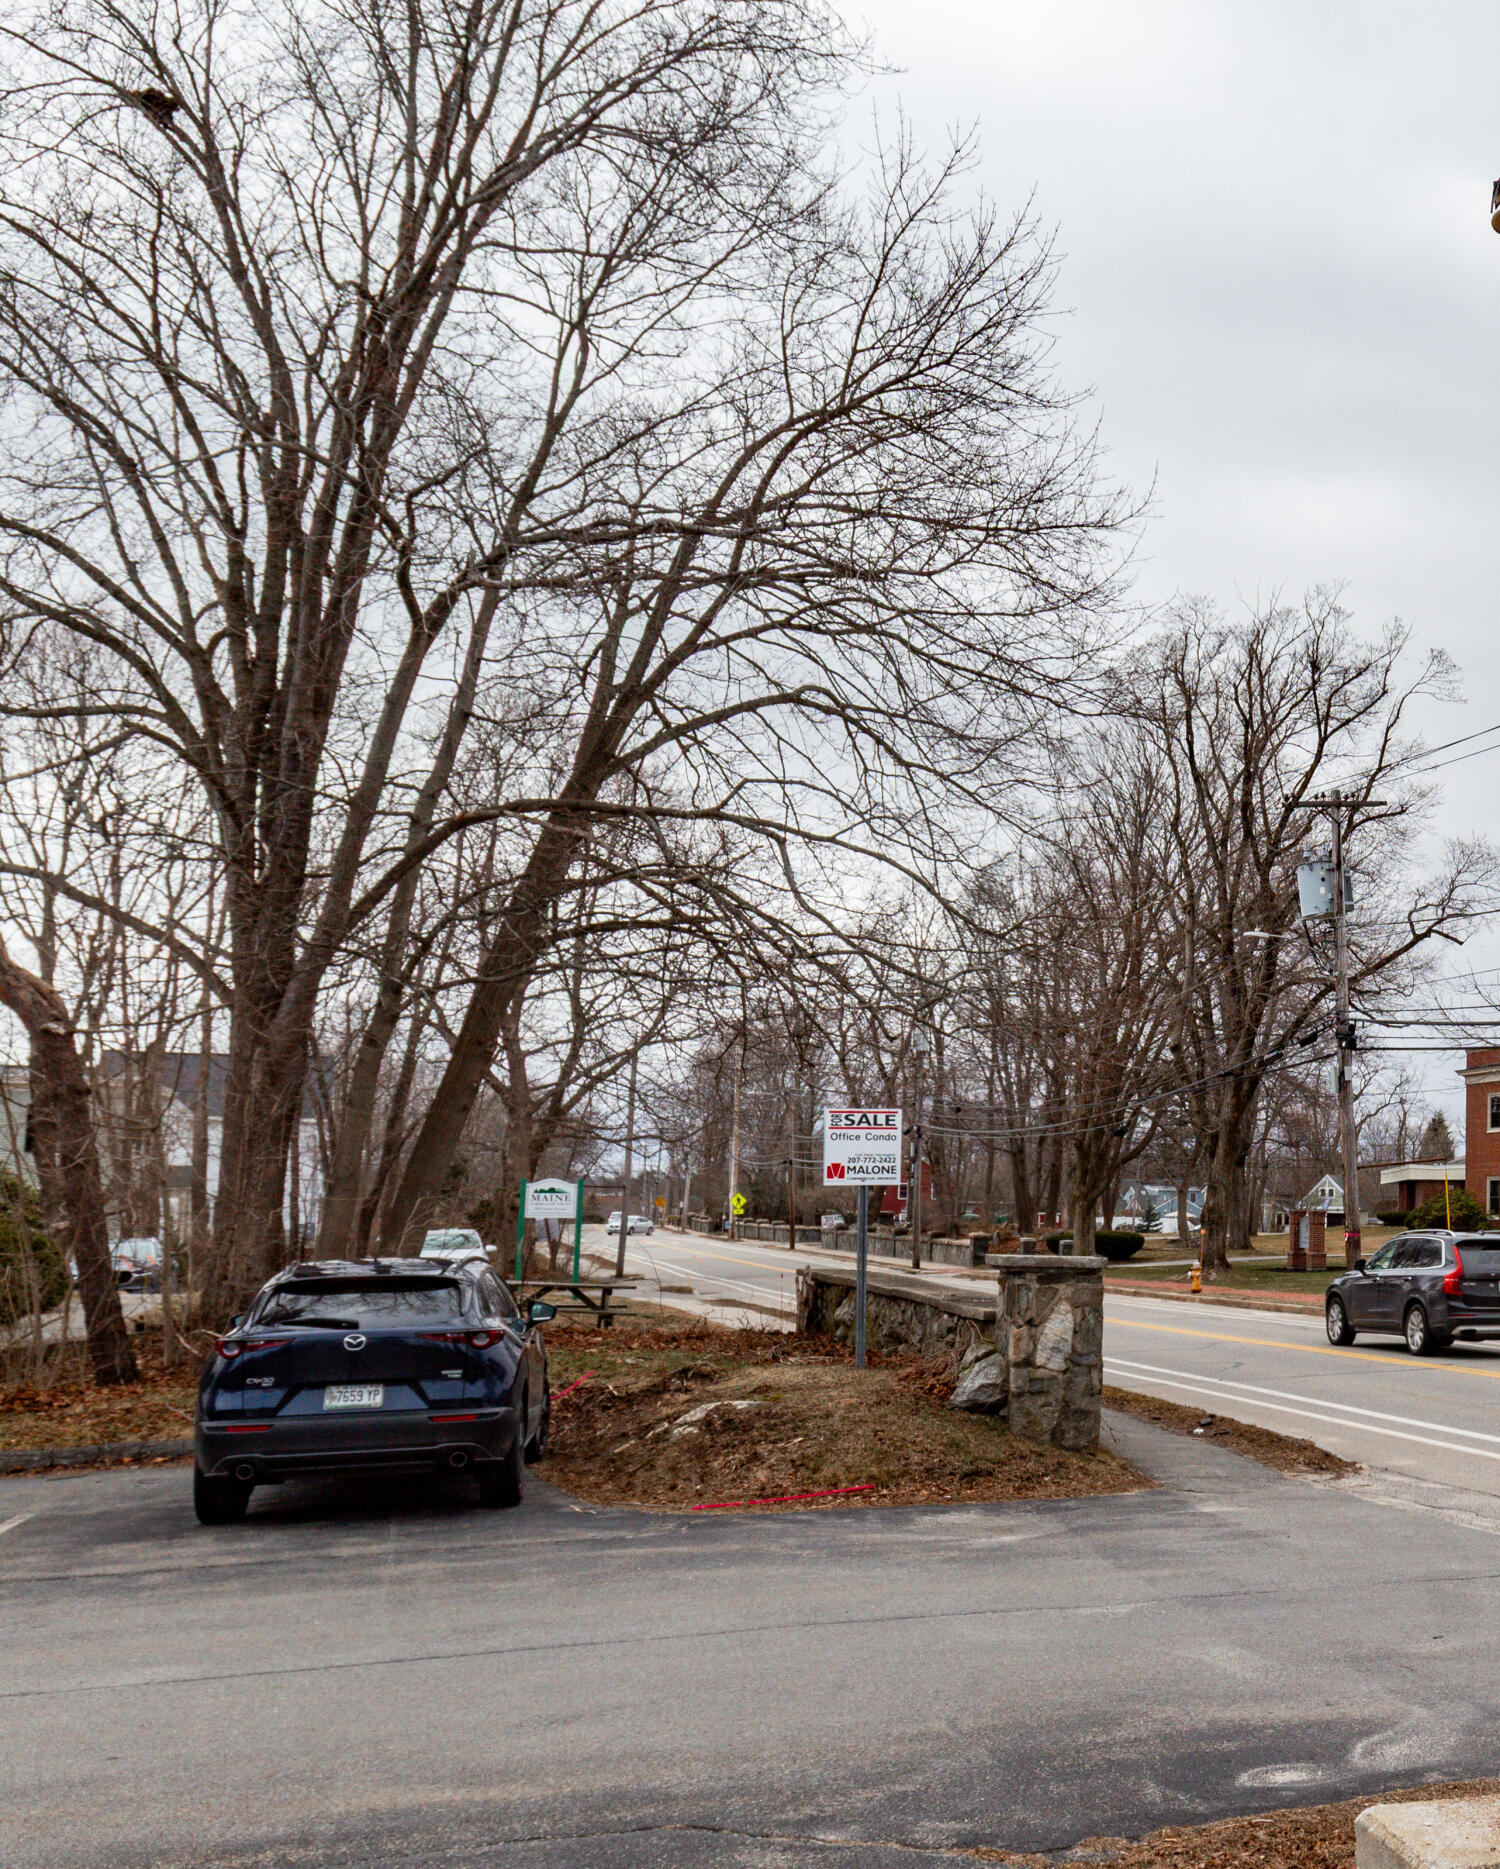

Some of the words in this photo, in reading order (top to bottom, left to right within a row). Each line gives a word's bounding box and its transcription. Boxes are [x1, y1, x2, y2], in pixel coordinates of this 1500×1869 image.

[831, 1114, 842, 1126] FOR
[843, 1112, 897, 1127] SALE
[830, 1132, 861, 1141] Office
[865, 1132, 897, 1141] Condo
[846, 1165, 897, 1175] MALONE
[531, 1194, 571, 1202] MAINE
[367, 1389, 380, 1402] YP
